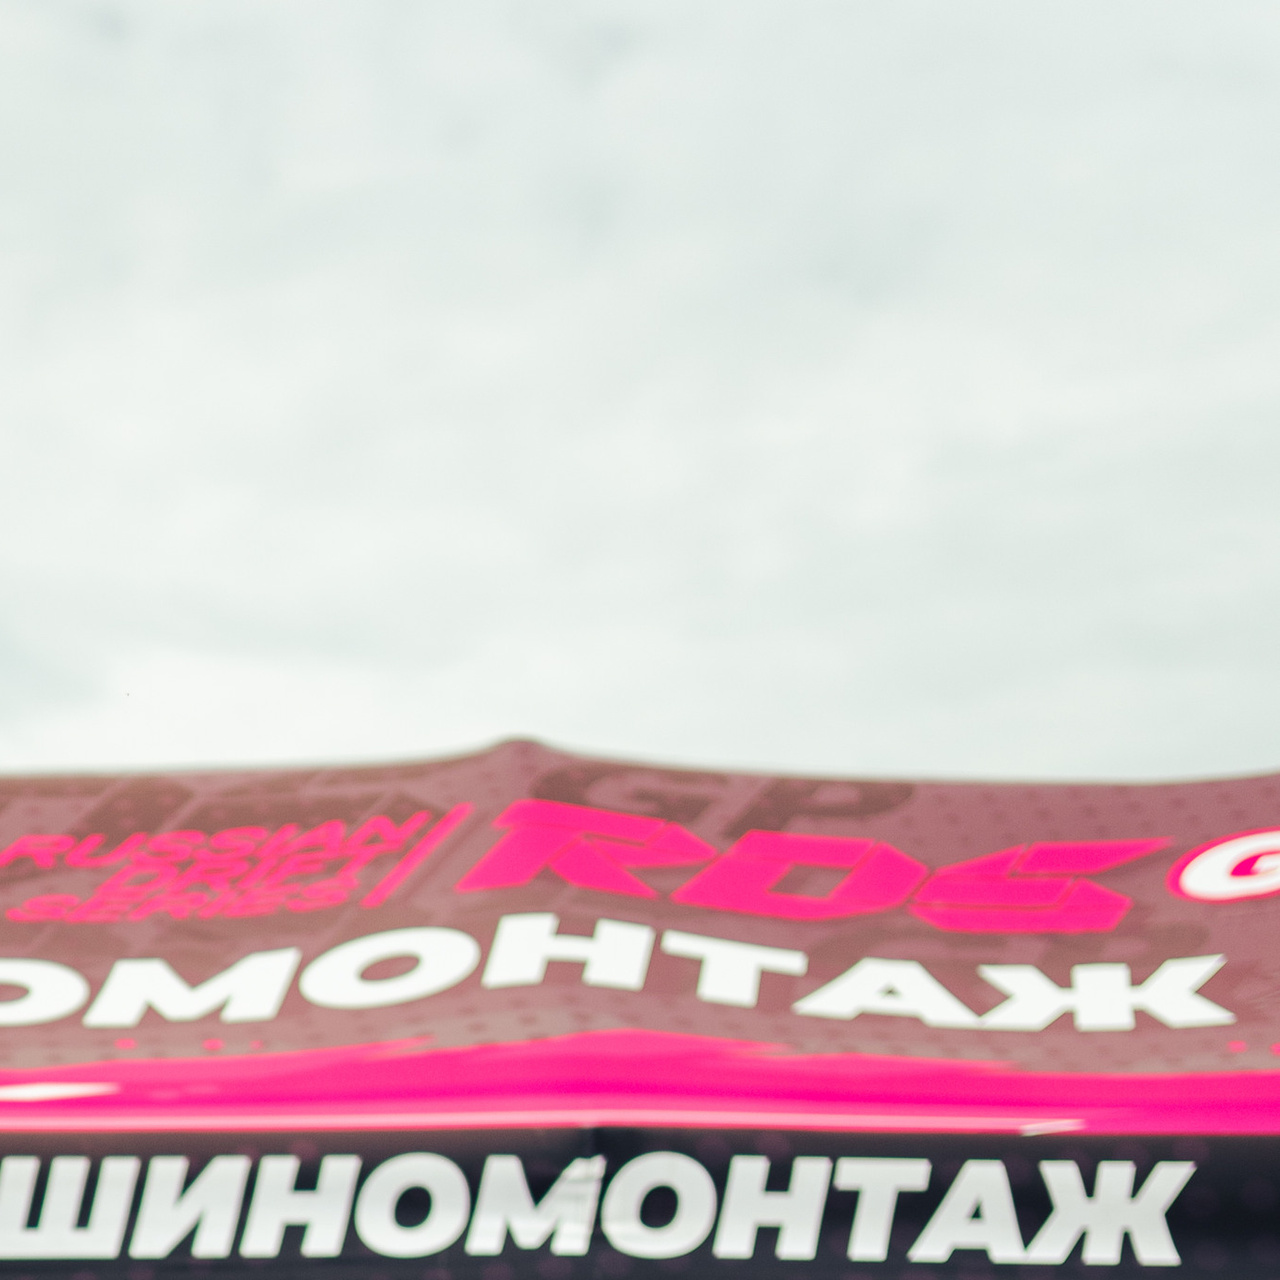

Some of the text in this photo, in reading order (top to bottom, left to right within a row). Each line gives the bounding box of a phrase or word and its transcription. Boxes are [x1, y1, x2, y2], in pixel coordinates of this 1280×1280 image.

[94, 843, 378, 896] DRIFT
[456, 799, 1280, 934] RDS G
[6, 874, 358, 923] SERIES
